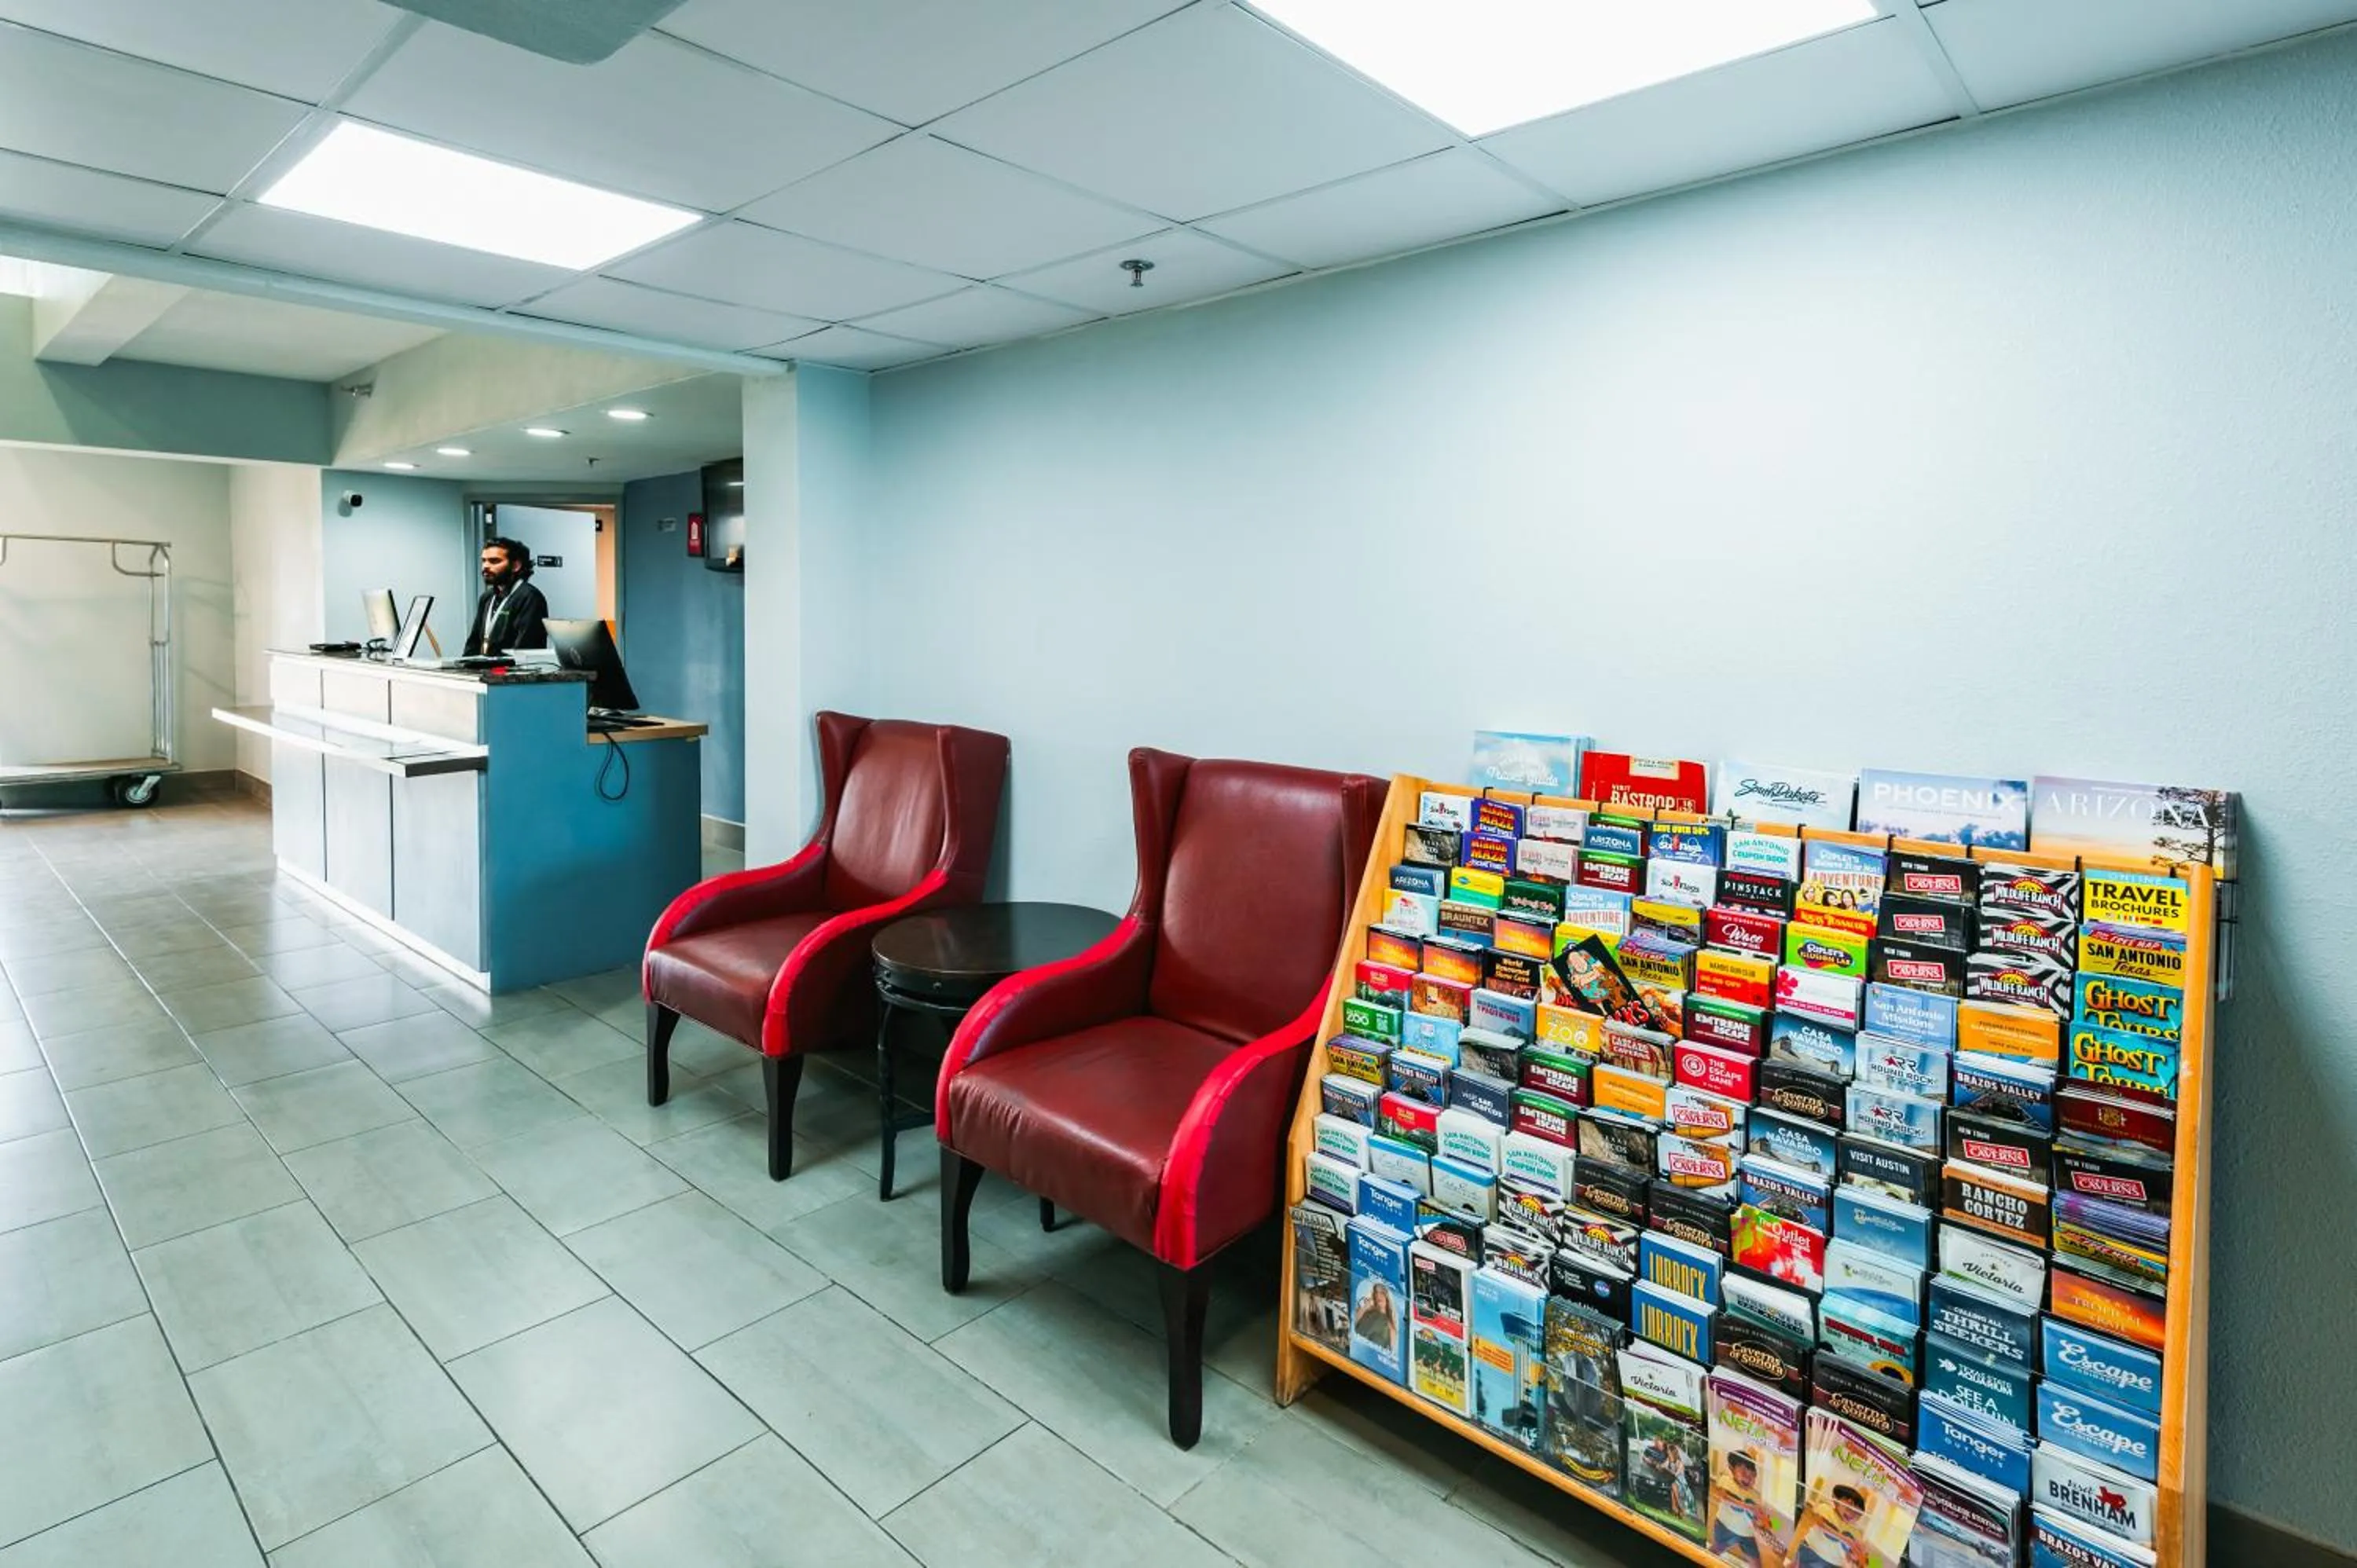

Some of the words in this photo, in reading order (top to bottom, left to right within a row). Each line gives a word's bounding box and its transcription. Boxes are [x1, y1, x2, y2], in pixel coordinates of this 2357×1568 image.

[1875, 782, 2017, 812] PHOENIX
[2045, 791, 2210, 827] ARIZONA
[1590, 836, 1631, 849] ARIZONA
[1724, 881, 1783, 899] PINSTACK
[2089, 882, 2182, 907] TRAVEL
[1441, 911, 1490, 927] BRAUNTEX
[2091, 899, 2179, 918] BROCHURES
[1721, 924, 1763, 943] Waco
[2088, 943, 2114, 958] SAN
[2121, 949, 2182, 970] ANTONIO
[2113, 962, 2151, 977] Texas
[2084, 980, 2179, 1019] GHOST
[1789, 1030, 1842, 1054] NAVARRO
[1801, 1026, 1832, 1041] CASA
[1709, 1058, 1726, 1069] THE
[2073, 1032, 2167, 1075] GHOST
[1956, 1072, 1997, 1091] BRAZOS
[2000, 1083, 2042, 1101] VALLEY
[1765, 1131, 1822, 1156] NAVARRO
[1778, 1127, 1809, 1143] CASA
[1849, 1150, 1874, 1166] VISIT
[1875, 1157, 1910, 1174] AUSTIN
[1783, 1186, 1819, 1204] VALLEY
[1962, 1183, 2028, 1214] RANCHO
[1965, 1200, 2025, 1229] CORTEZ
[1772, 1221, 1811, 1247] Outlet
[1963, 1262, 2024, 1294] Victoria
[1940, 1309, 2017, 1345] THRILL
[1732, 1343, 1781, 1365] Caverns
[1934, 1321, 2024, 1361] SEEKERS
[2058, 1339, 2153, 1389] Escape
[1631, 1376, 1677, 1397] Victoria
[1956, 1385, 1981, 1403] SEE
[1985, 1398, 1997, 1409] A
[1831, 1392, 1888, 1421] Caverns
[1941, 1421, 2007, 1459] Tanger
[2051, 1401, 2147, 1453] Escape
[2048, 1479, 2136, 1530] BRENHAM
[2039, 1530, 2089, 1563] BRAZOS
